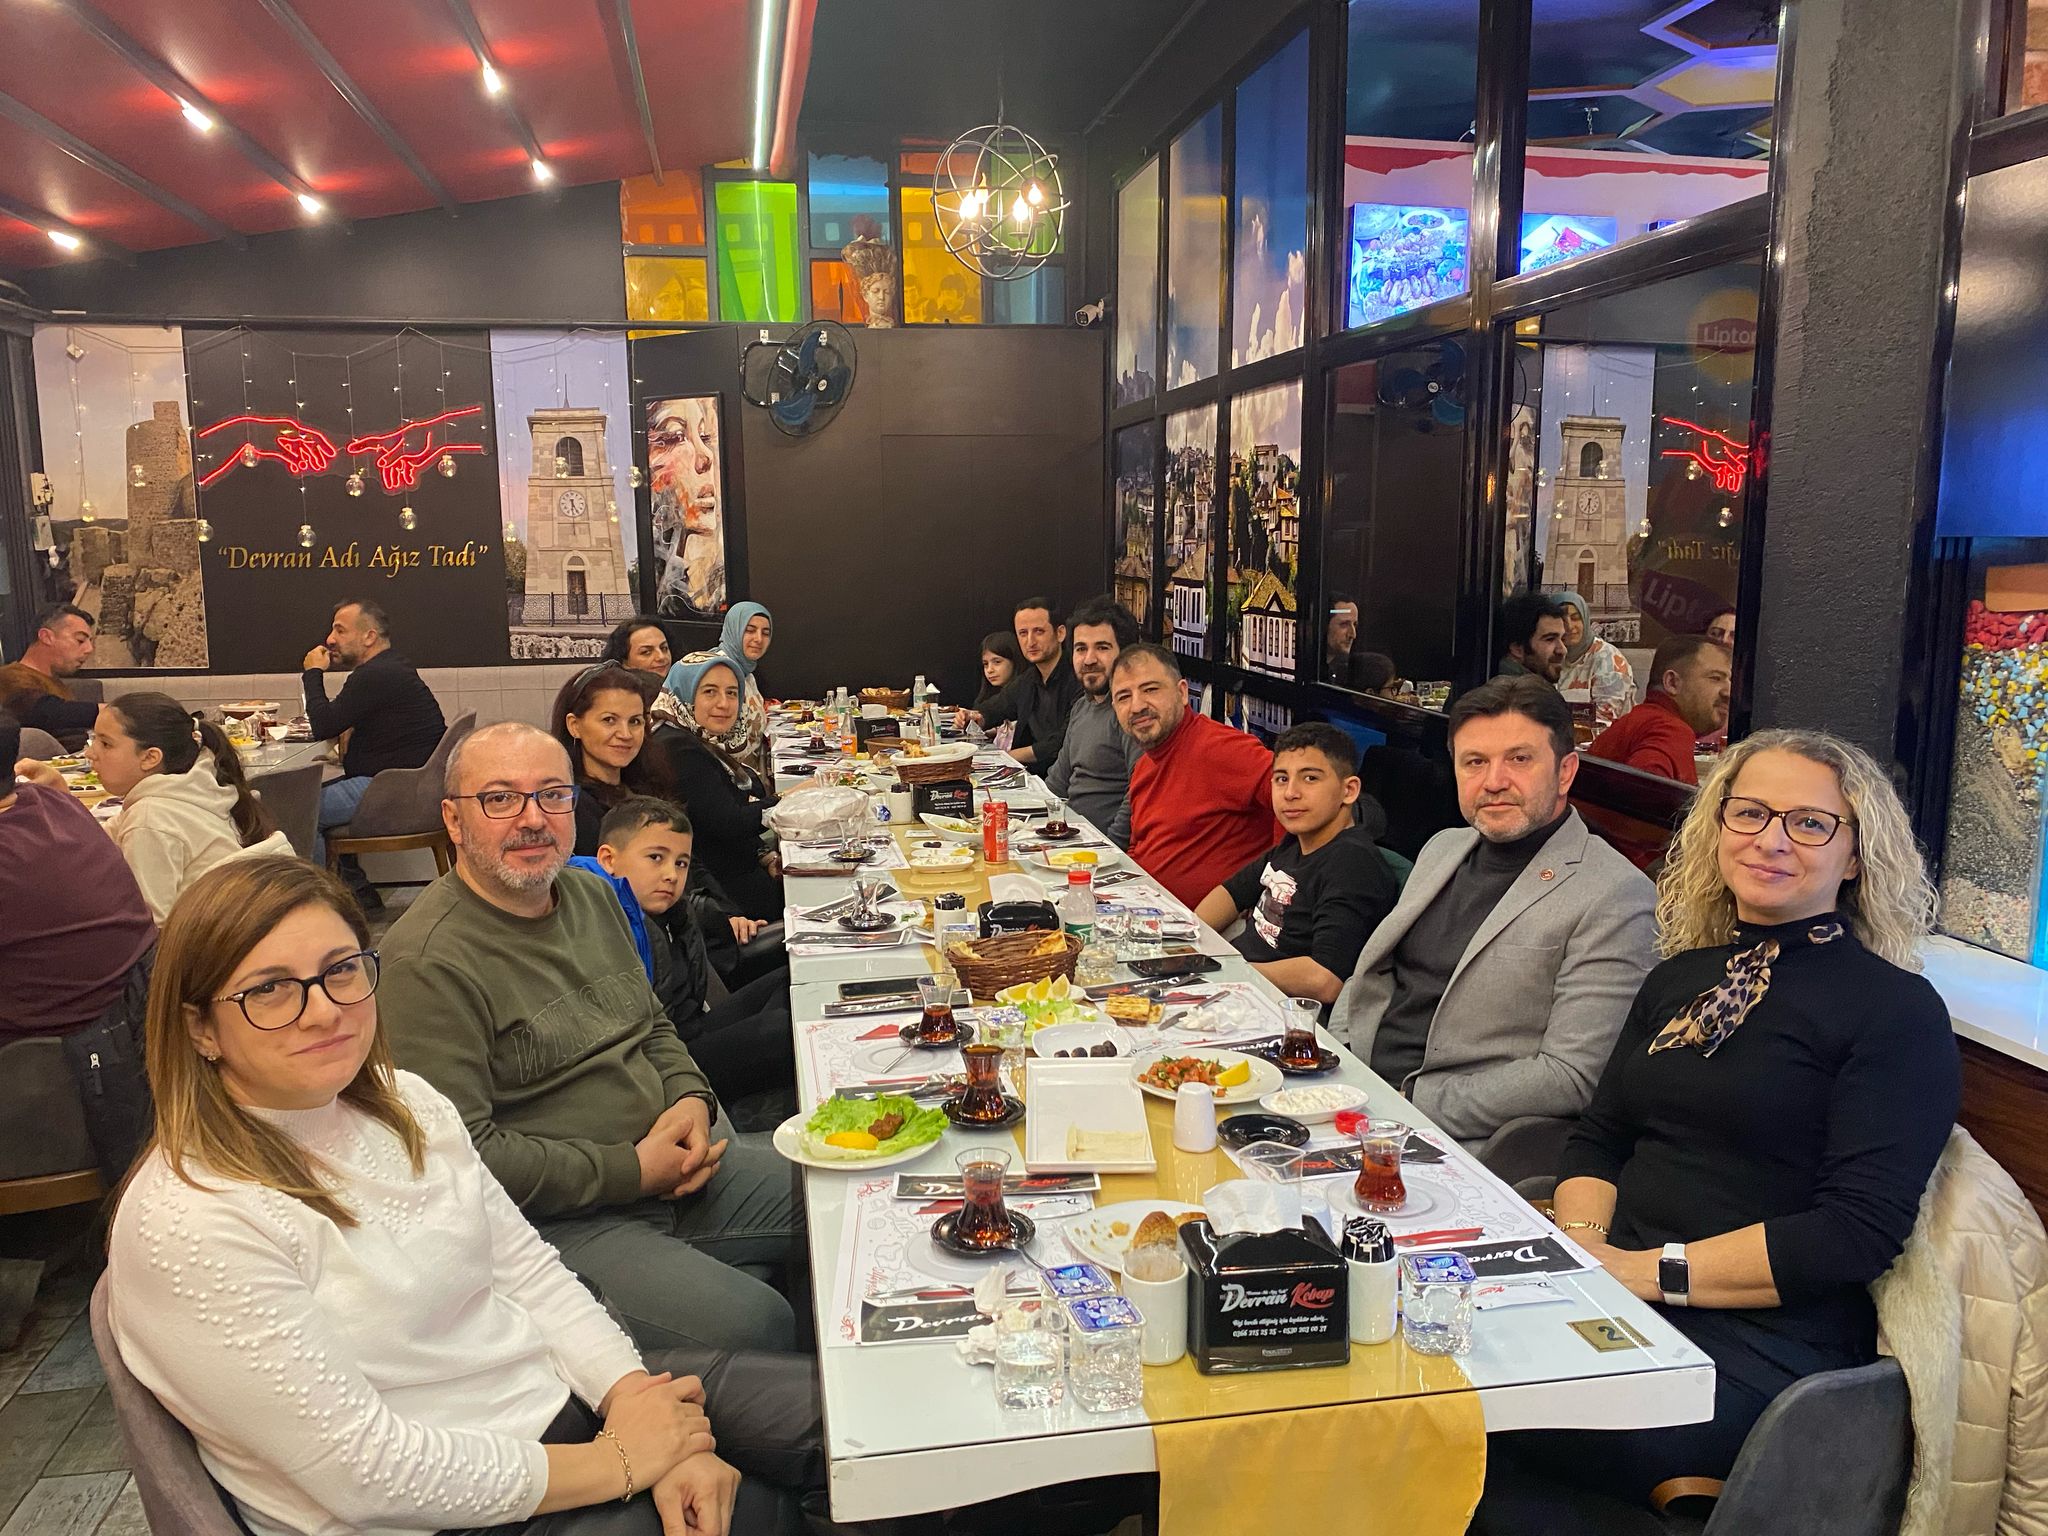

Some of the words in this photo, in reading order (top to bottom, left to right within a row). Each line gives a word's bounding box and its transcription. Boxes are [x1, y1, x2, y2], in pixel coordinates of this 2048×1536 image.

[318, 541, 361, 568] Adı
[368, 544, 420, 578] Ağız
[1464, 1245, 1549, 1262] Devra
[1220, 1283, 1288, 1312] Devran
[1290, 1282, 1335, 1309] Kebap
[1597, 1325, 1625, 1342] 2
